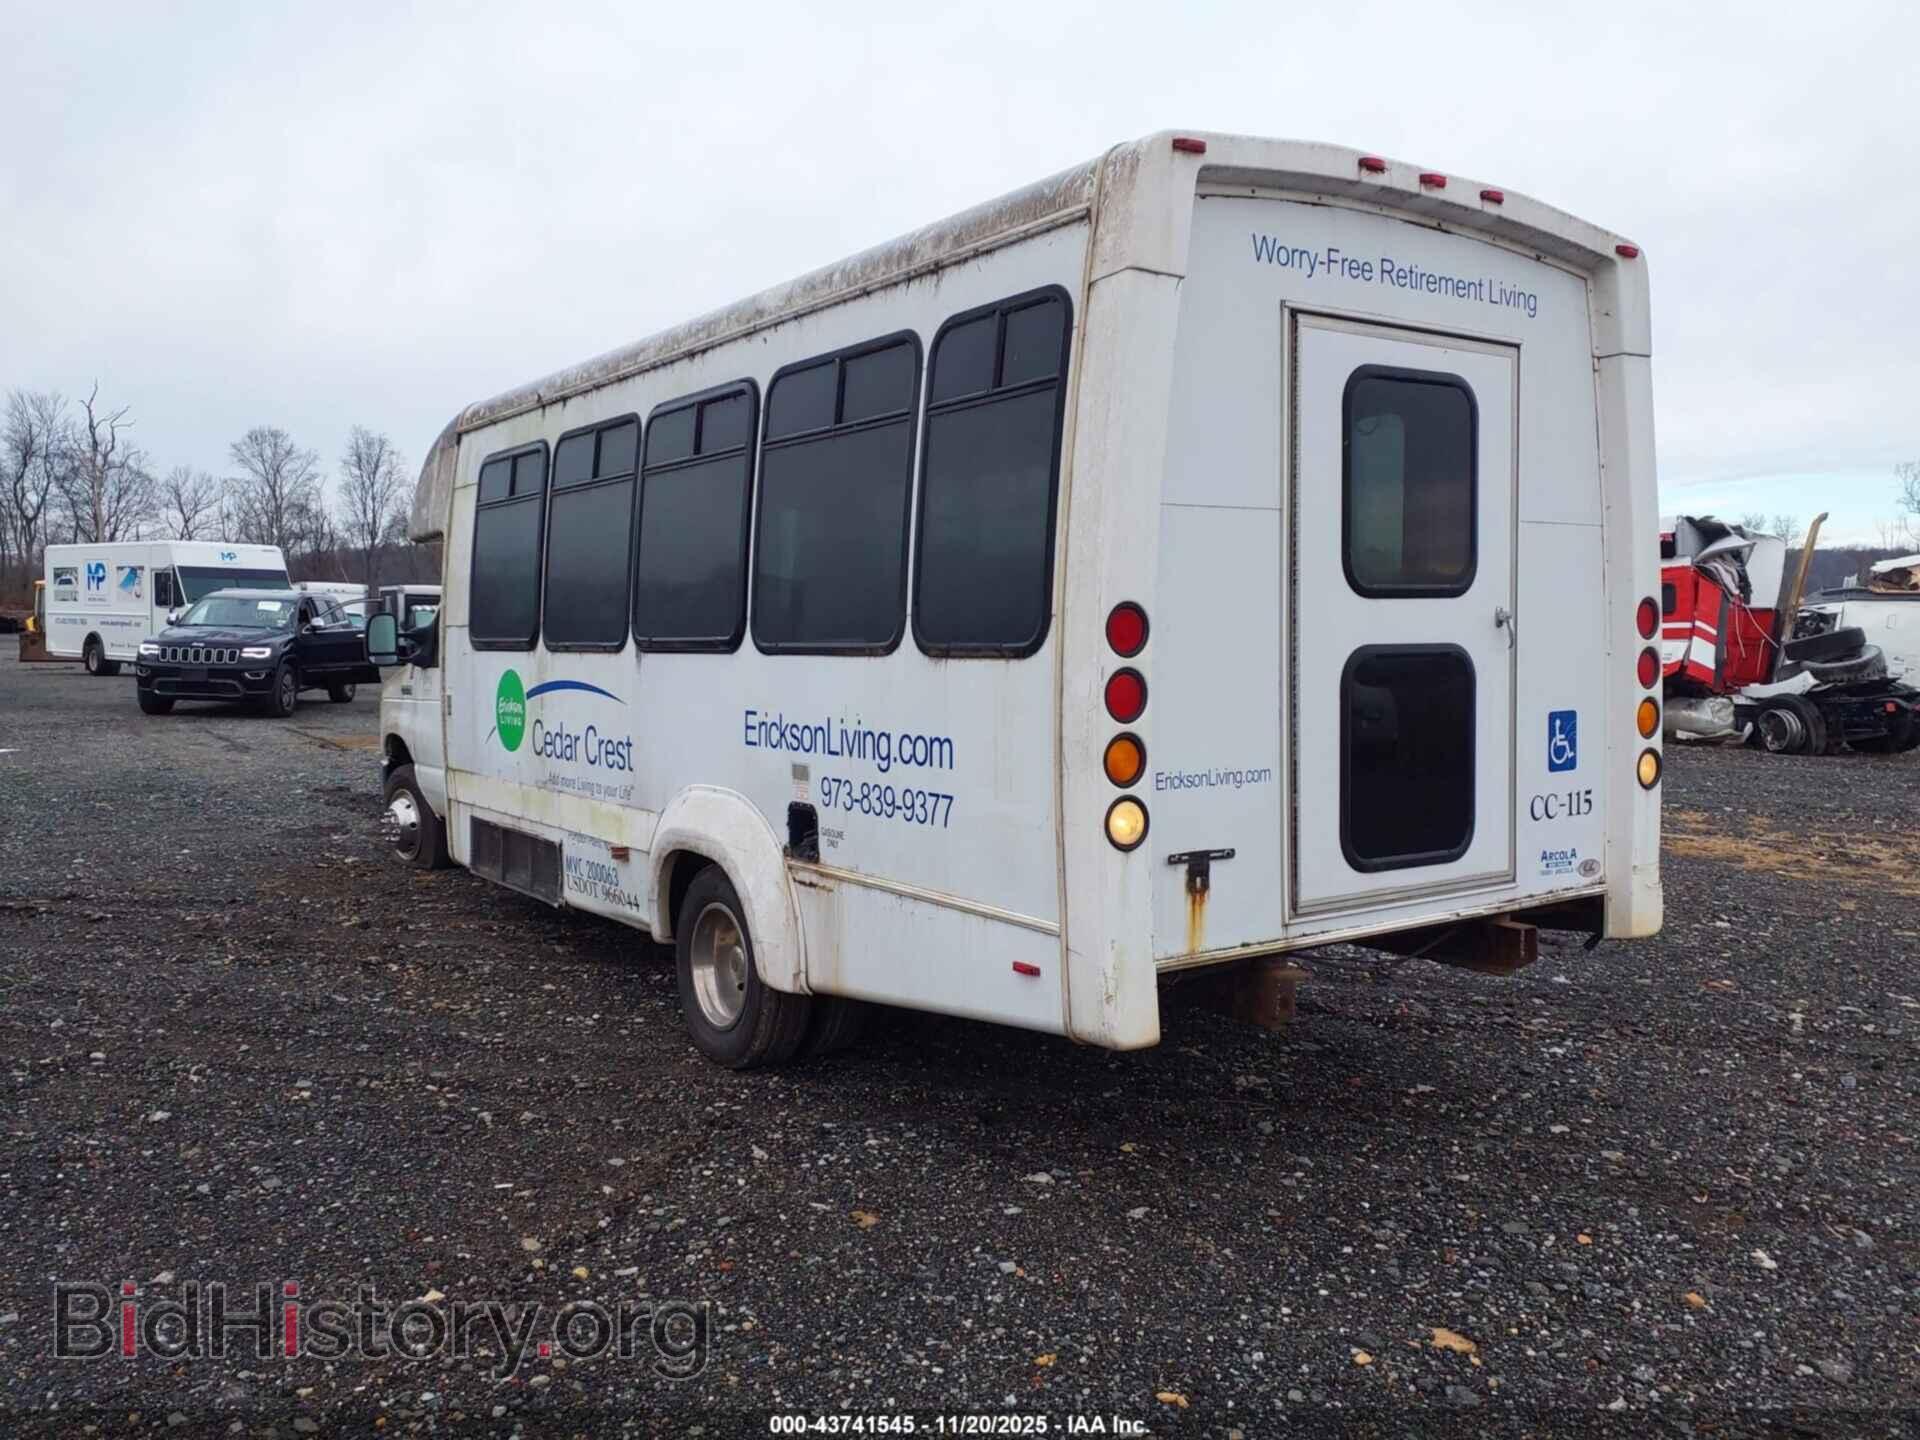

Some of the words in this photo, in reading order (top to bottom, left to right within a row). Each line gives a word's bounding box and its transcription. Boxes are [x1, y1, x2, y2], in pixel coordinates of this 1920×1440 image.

[1252, 232, 1373, 281] Worry-Free
[1380, 257, 1485, 302] Retirement
[1488, 278, 1538, 318] Living
[87, 561, 107, 591] MP
[532, 718, 580, 763] Cedar
[584, 724, 634, 773] Crest
[744, 709, 954, 773] EricksonLiving.com
[1155, 767, 1272, 792] EricksonLiving.com
[820, 775, 955, 829] 973-839-9377
[1530, 788, 1593, 822] CC-115
[565, 853, 584, 878] MVC
[585, 860, 619, 887] 200063
[1540, 847, 1578, 862] ARCOLA
[601, 884, 640, 913] 966044
